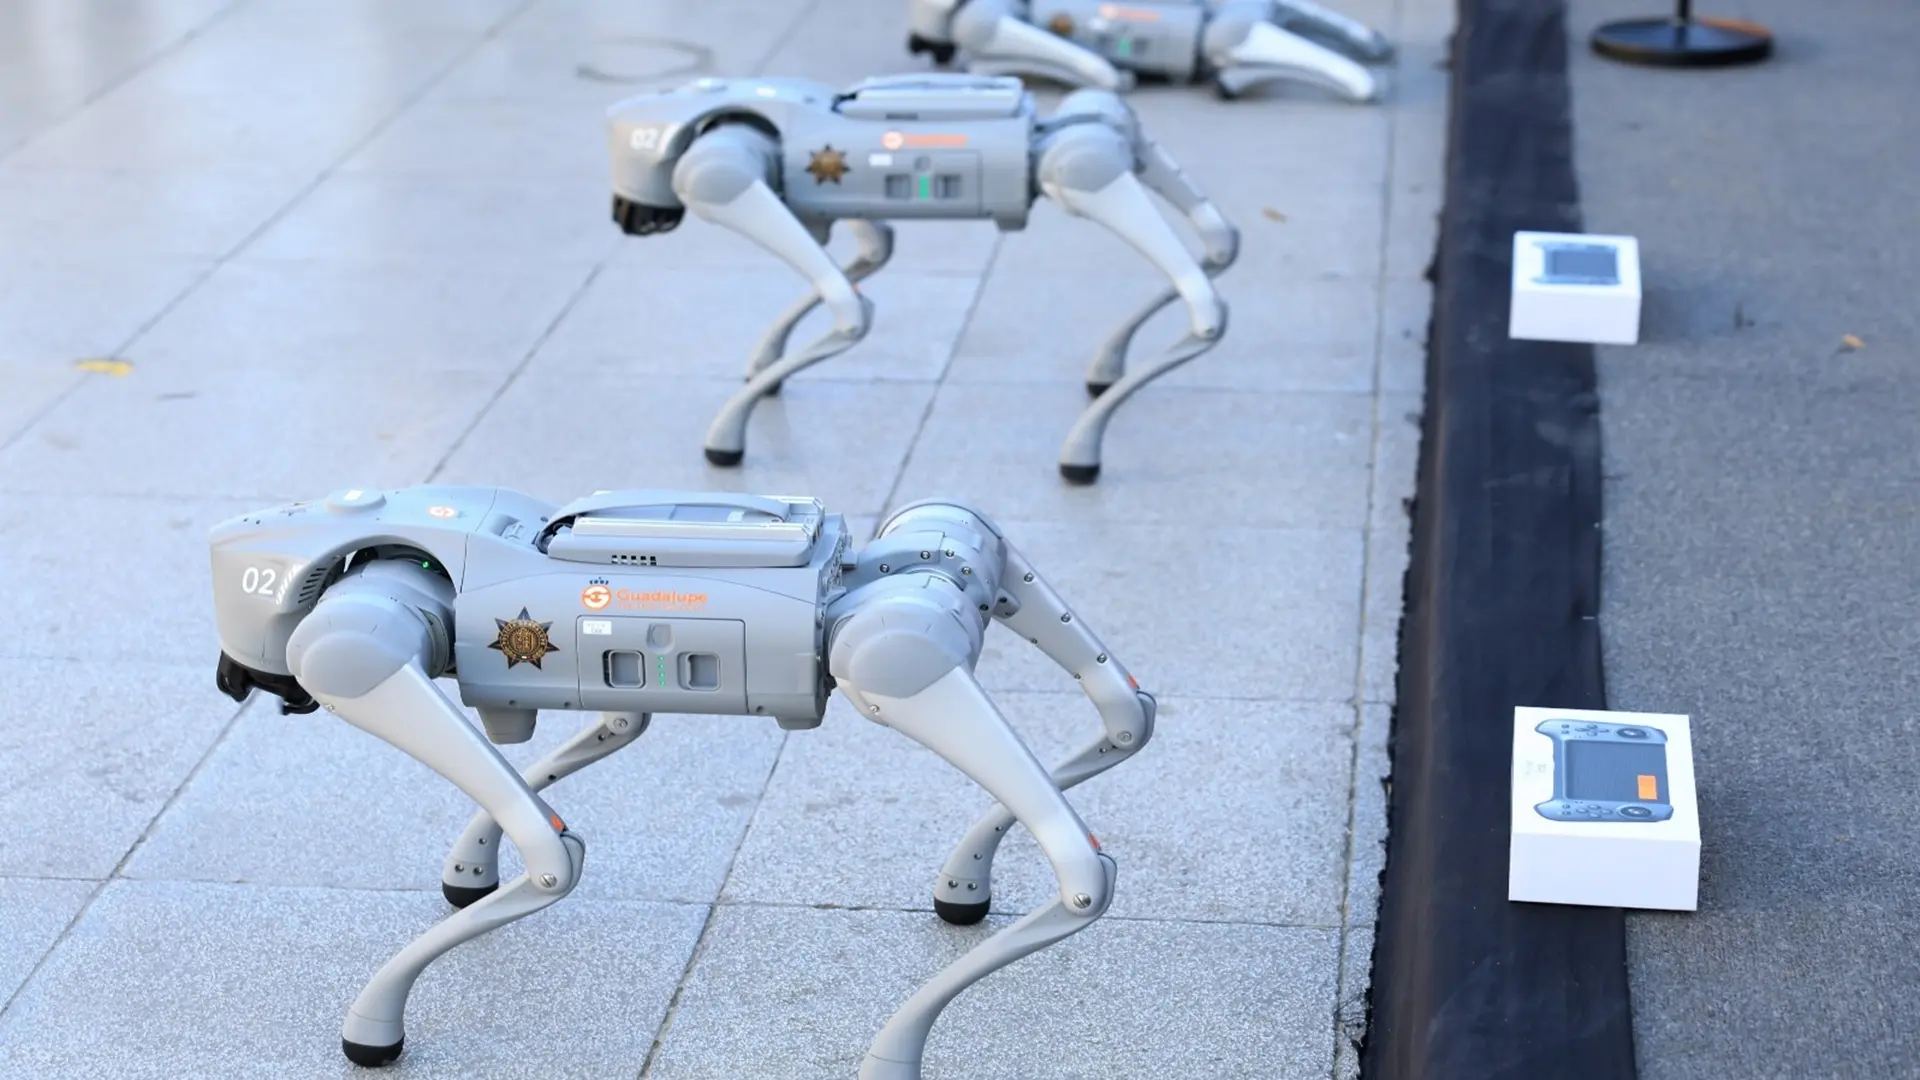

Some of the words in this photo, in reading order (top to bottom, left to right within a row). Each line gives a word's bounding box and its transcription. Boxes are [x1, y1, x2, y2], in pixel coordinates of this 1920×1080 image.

[631, 129, 658, 149] 02
[242, 567, 276, 595] 02
[616, 588, 708, 604] Guadalupe
